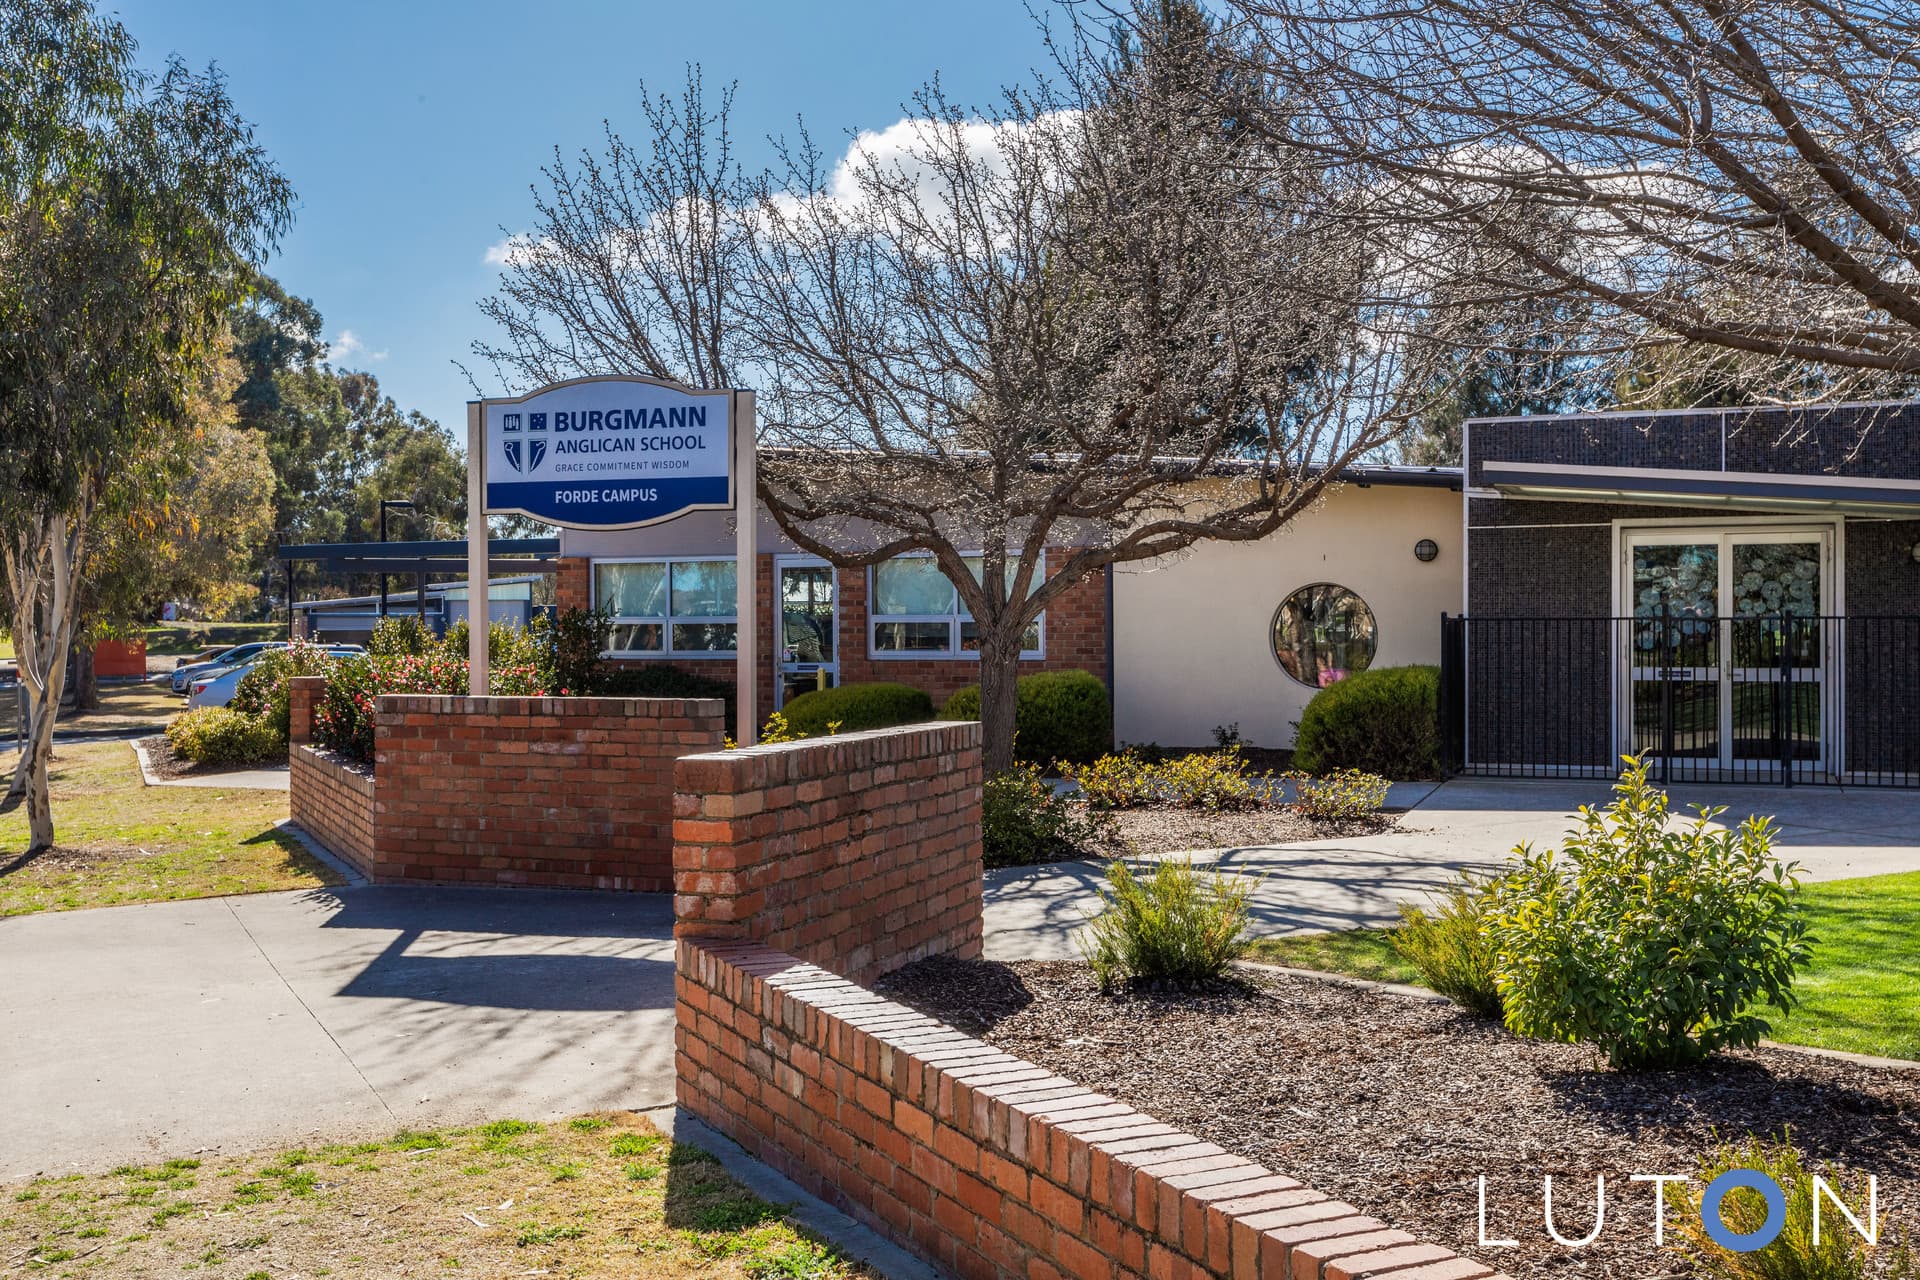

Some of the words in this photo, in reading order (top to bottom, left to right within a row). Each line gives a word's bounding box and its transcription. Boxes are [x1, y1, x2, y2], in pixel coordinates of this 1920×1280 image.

[554, 405, 707, 432] BURGMANN
[555, 438, 635, 454] ANGLICAN
[641, 435, 706, 451] SCHOOL
[555, 463, 584, 473] GRACE
[586, 461, 648, 472] COMMITMENT
[651, 460, 690, 470] WISDOM
[555, 490, 599, 504] FORDE
[601, 488, 658, 502] CAMPUS
